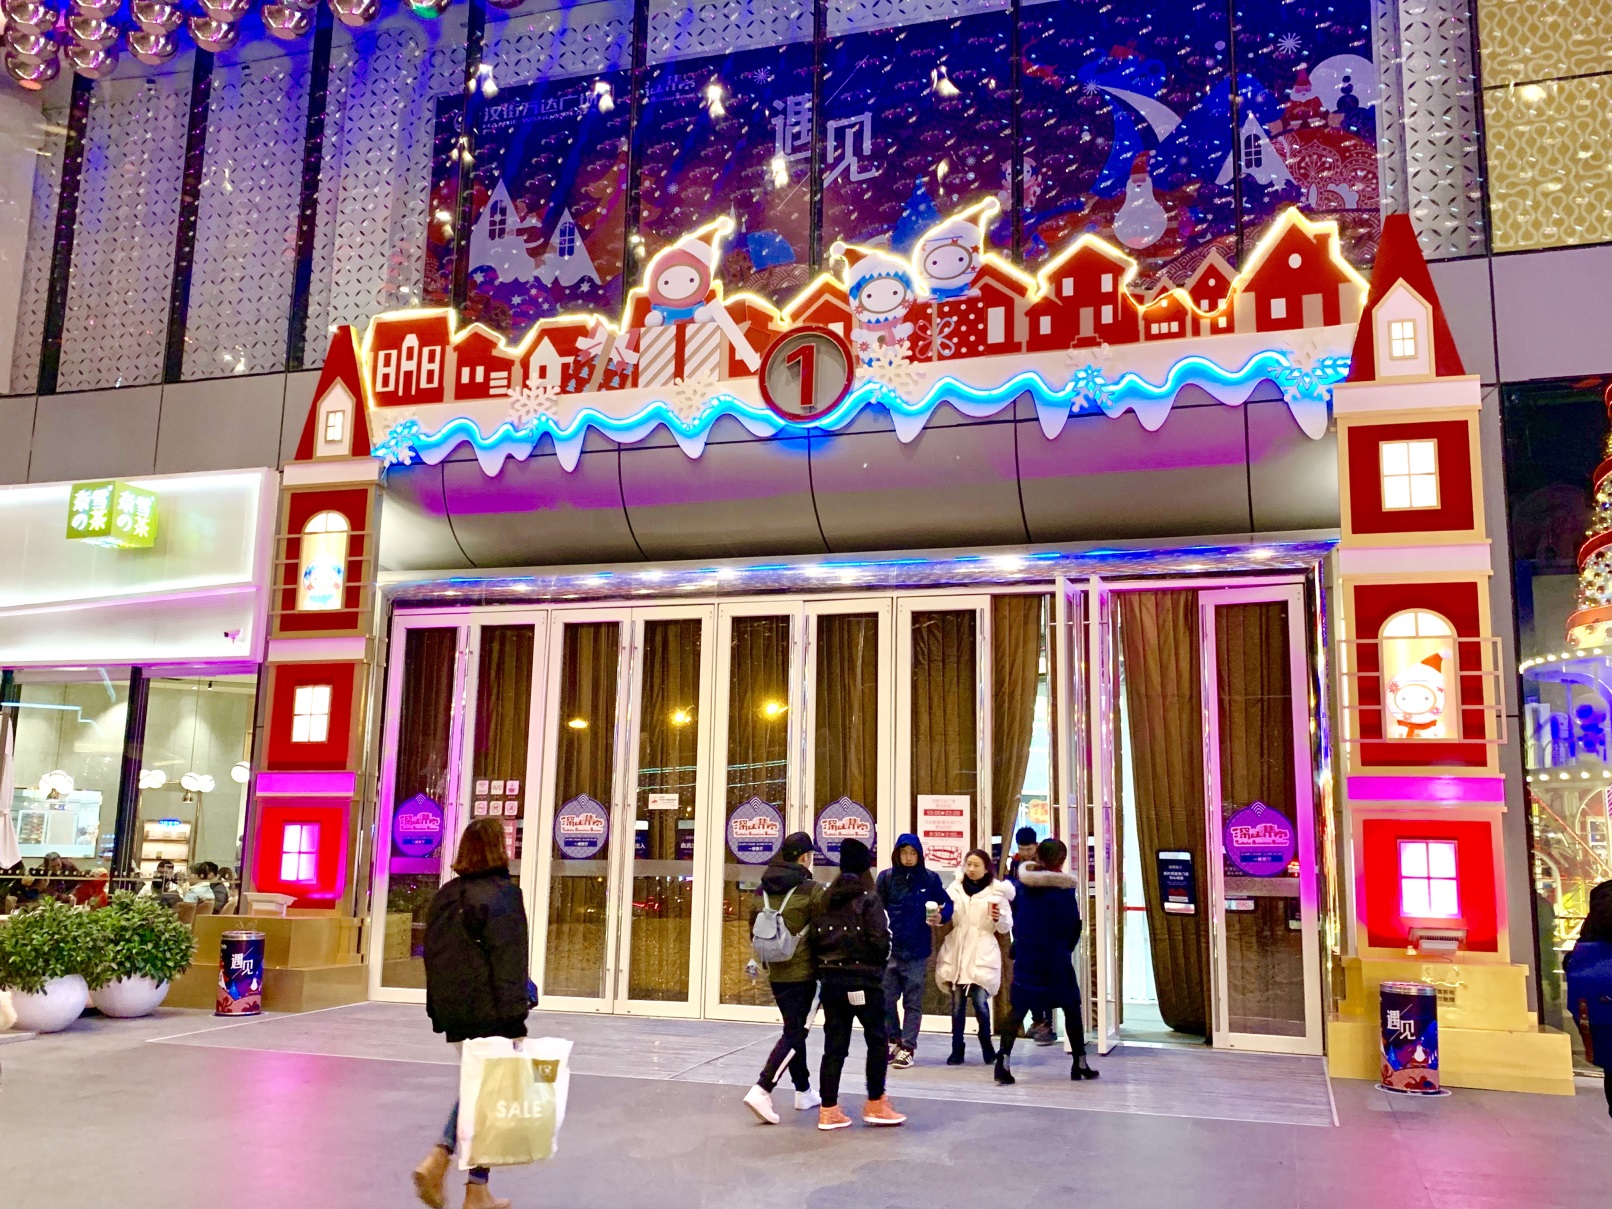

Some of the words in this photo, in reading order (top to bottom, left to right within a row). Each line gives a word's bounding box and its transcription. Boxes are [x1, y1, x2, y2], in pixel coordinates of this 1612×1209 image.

[786, 343, 816, 407] 1
[231, 953, 254, 975] 遇见
[1386, 1009, 1416, 1040] 遇见
[495, 1100, 542, 1118] SALE
